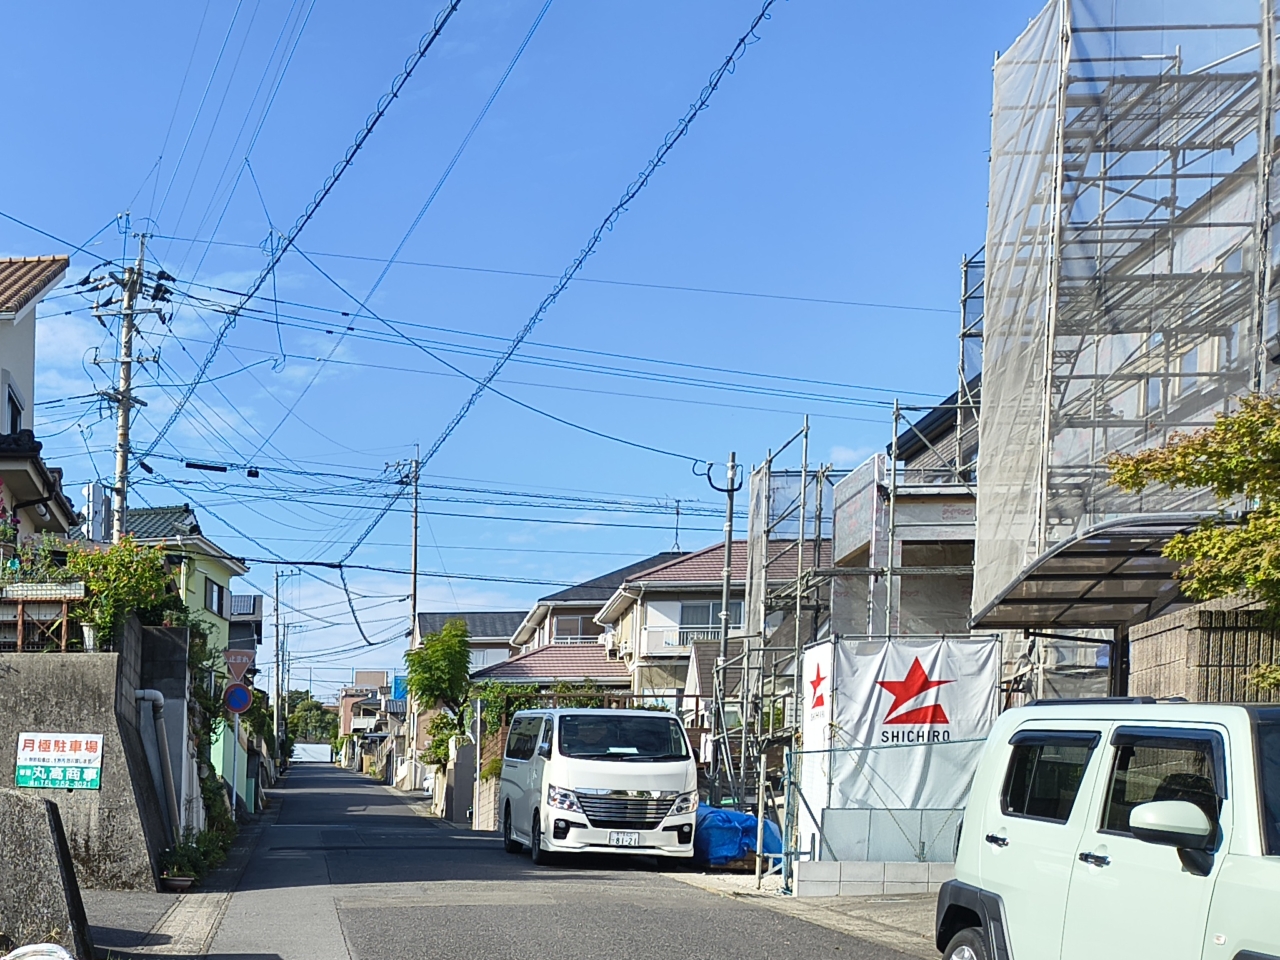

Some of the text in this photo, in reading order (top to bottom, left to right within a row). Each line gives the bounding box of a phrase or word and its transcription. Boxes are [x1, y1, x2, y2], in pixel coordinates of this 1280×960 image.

[229, 655, 249, 663] 止まれ
[881, 730, 950, 743] SHICHIRO
[22, 739, 98, 754] 月極駐車場
[32, 766, 98, 781] 丸高商事
